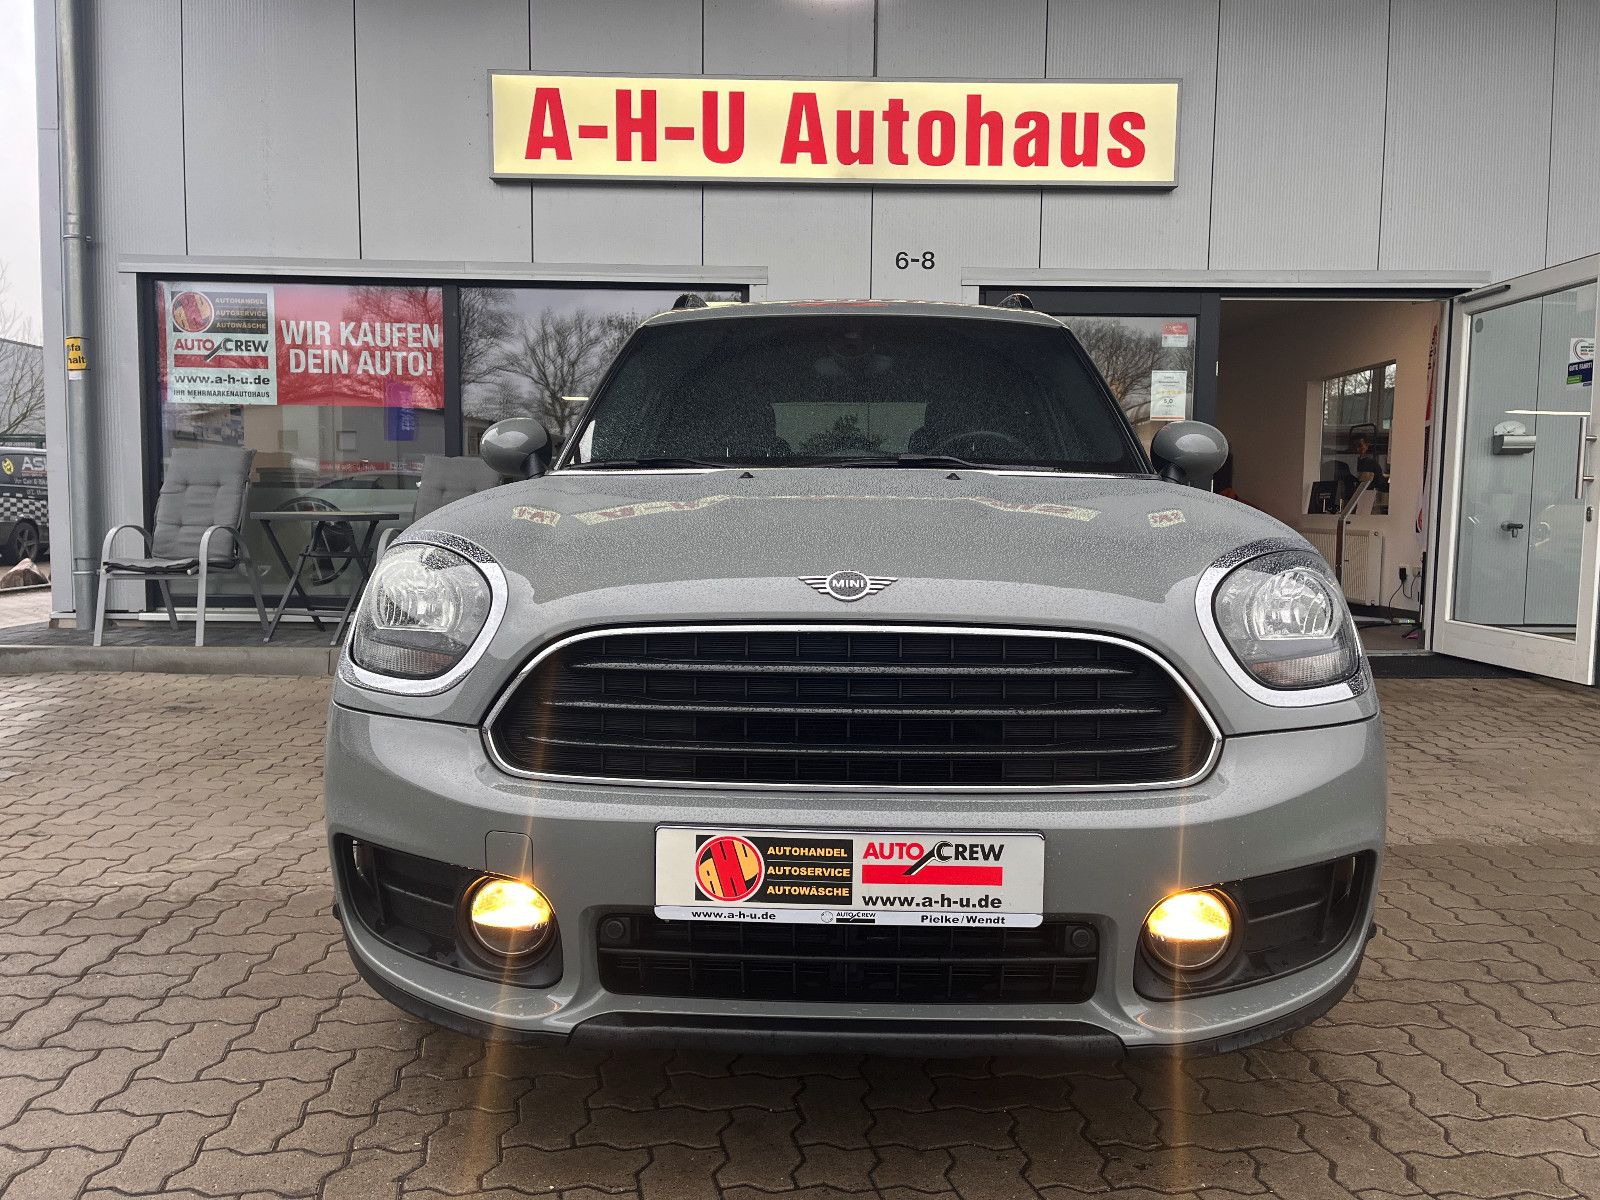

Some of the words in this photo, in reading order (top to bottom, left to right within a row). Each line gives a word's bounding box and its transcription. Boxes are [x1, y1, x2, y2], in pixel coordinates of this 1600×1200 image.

[525, 87, 745, 165] A-H-U
[780, 92, 1146, 169] Autohaus
[895, 251, 936, 270] 6-8
[214, 297, 265, 305] AUTOHANDEL
[216, 321, 267, 329] AUTOWÄSCHE
[281, 320, 331, 346] WIR
[340, 321, 439, 348] KAUFEN
[289, 349, 349, 375] DEIN
[356, 351, 433, 377] AUTO!
[174, 374, 270, 385] www.a-h-u.de
[187, 389, 271, 398] MEHRMARKENAUTOHAUS
[832, 579, 864, 588] MINI
[767, 846, 848, 857] AUTOHANDEL
[767, 865, 851, 877] AUTOSERVICE
[767, 885, 850, 897] AUTOWÄSCHE
[862, 894, 1003, 909] www.a-h-u.de
[691, 911, 777, 920] www.a-h-u.de
